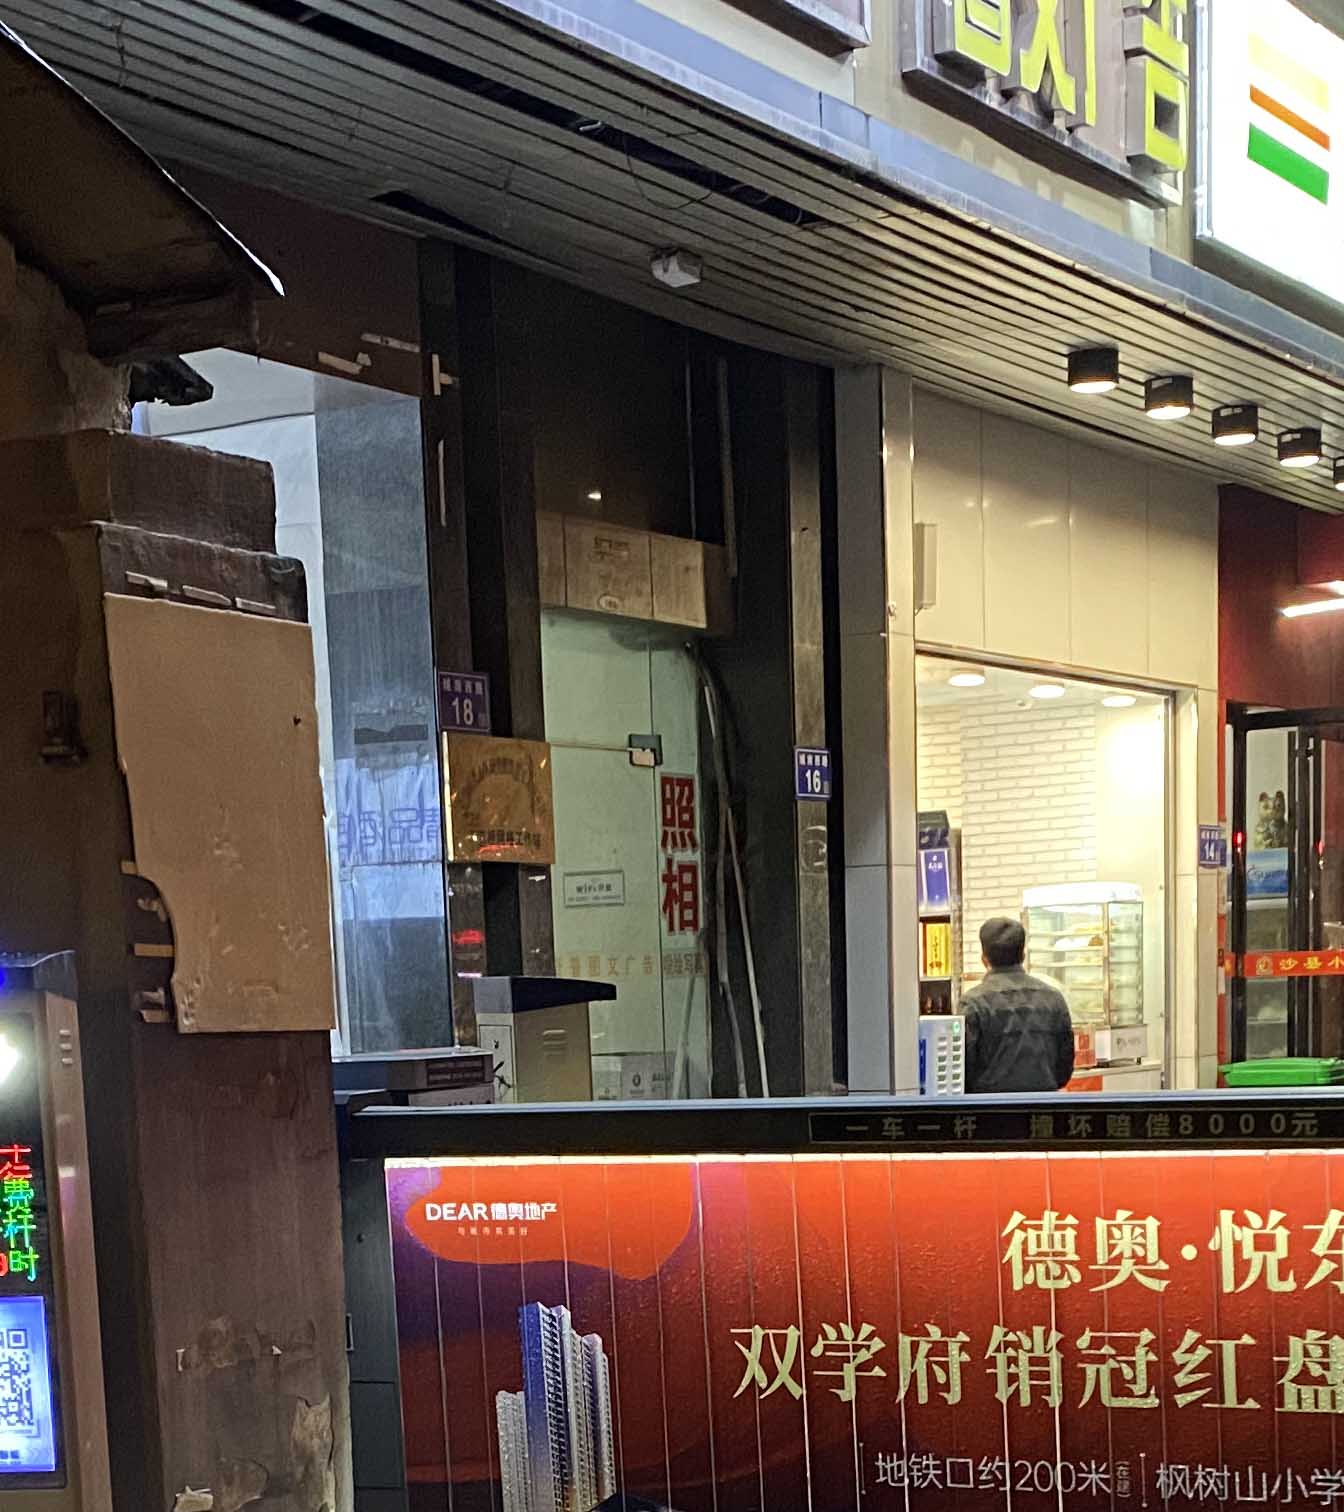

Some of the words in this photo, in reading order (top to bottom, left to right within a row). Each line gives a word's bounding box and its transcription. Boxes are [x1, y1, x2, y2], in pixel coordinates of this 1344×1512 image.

[452, 697, 474, 725] 18
[805, 769, 821, 793] 16
[661, 775, 700, 935] 照相
[845, 1116, 978, 1140] 一车一杆
[1029, 1111, 1320, 1139] 撞坏赔偿8000元
[425, 1203, 489, 1221] DEAR
[490, 1202, 558, 1221] 德奥地产
[874, 1452, 1112, 1497] 地铁口约200米
